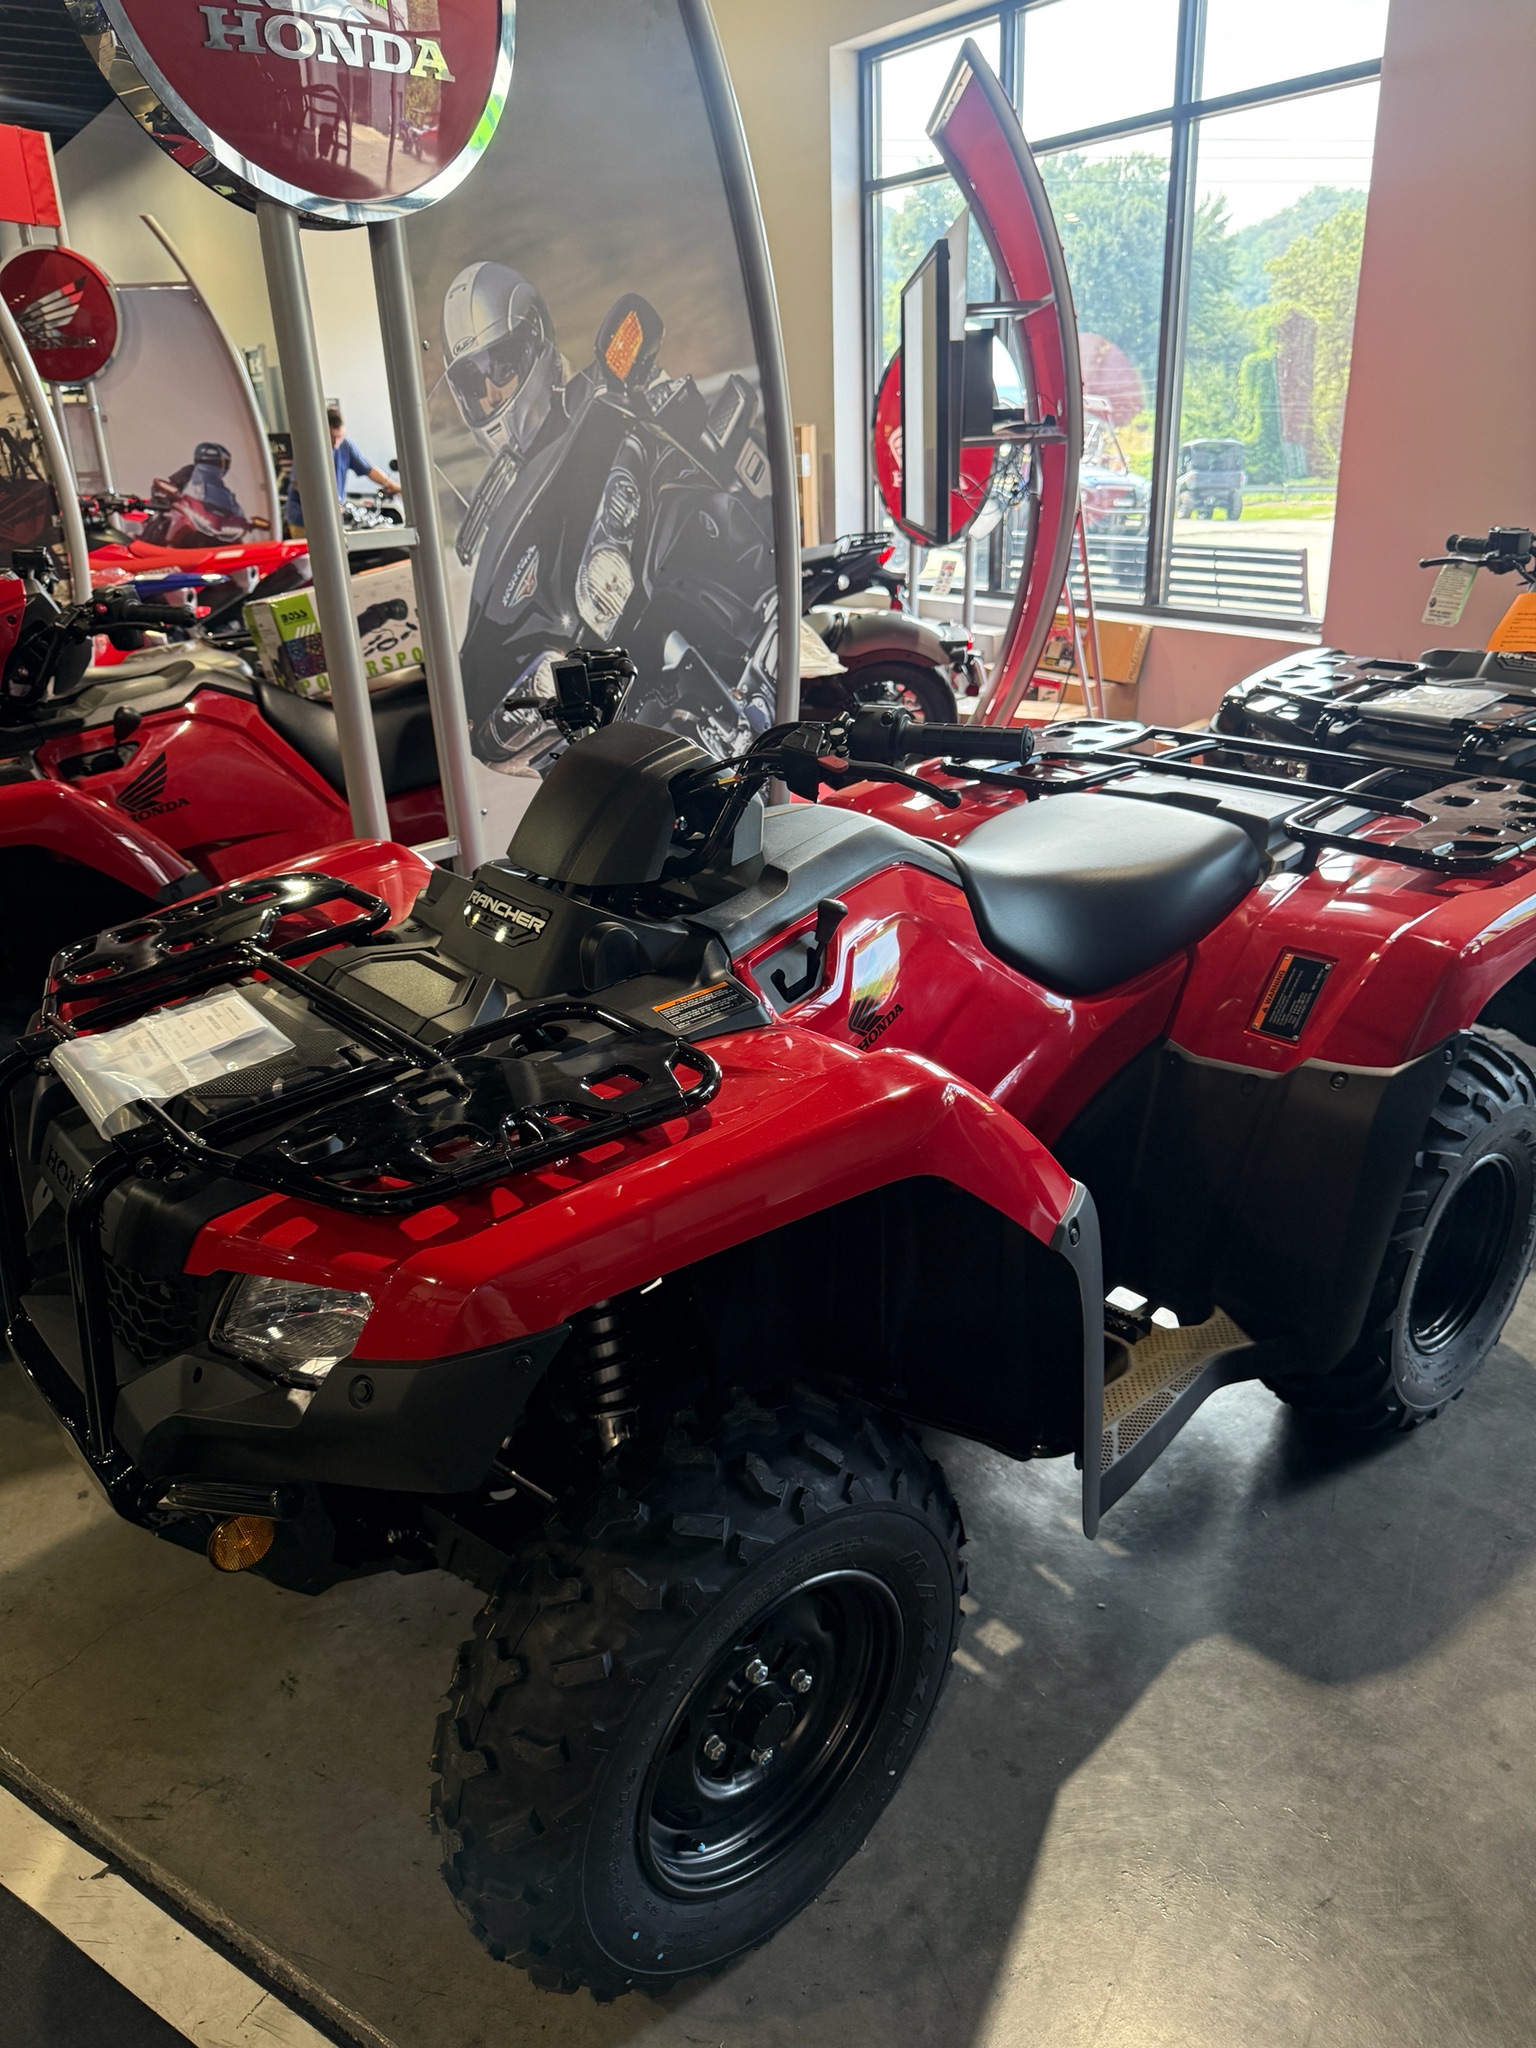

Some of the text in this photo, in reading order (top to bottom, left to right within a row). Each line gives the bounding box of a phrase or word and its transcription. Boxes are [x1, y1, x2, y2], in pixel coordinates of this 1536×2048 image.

[199, 5, 455, 83] HONDA
[280, 610, 308, 624] BOSS
[468, 889, 547, 934] RANCHER
[1264, 969, 1286, 1006] WARNING
[857, 1003, 904, 1050] HONDA
